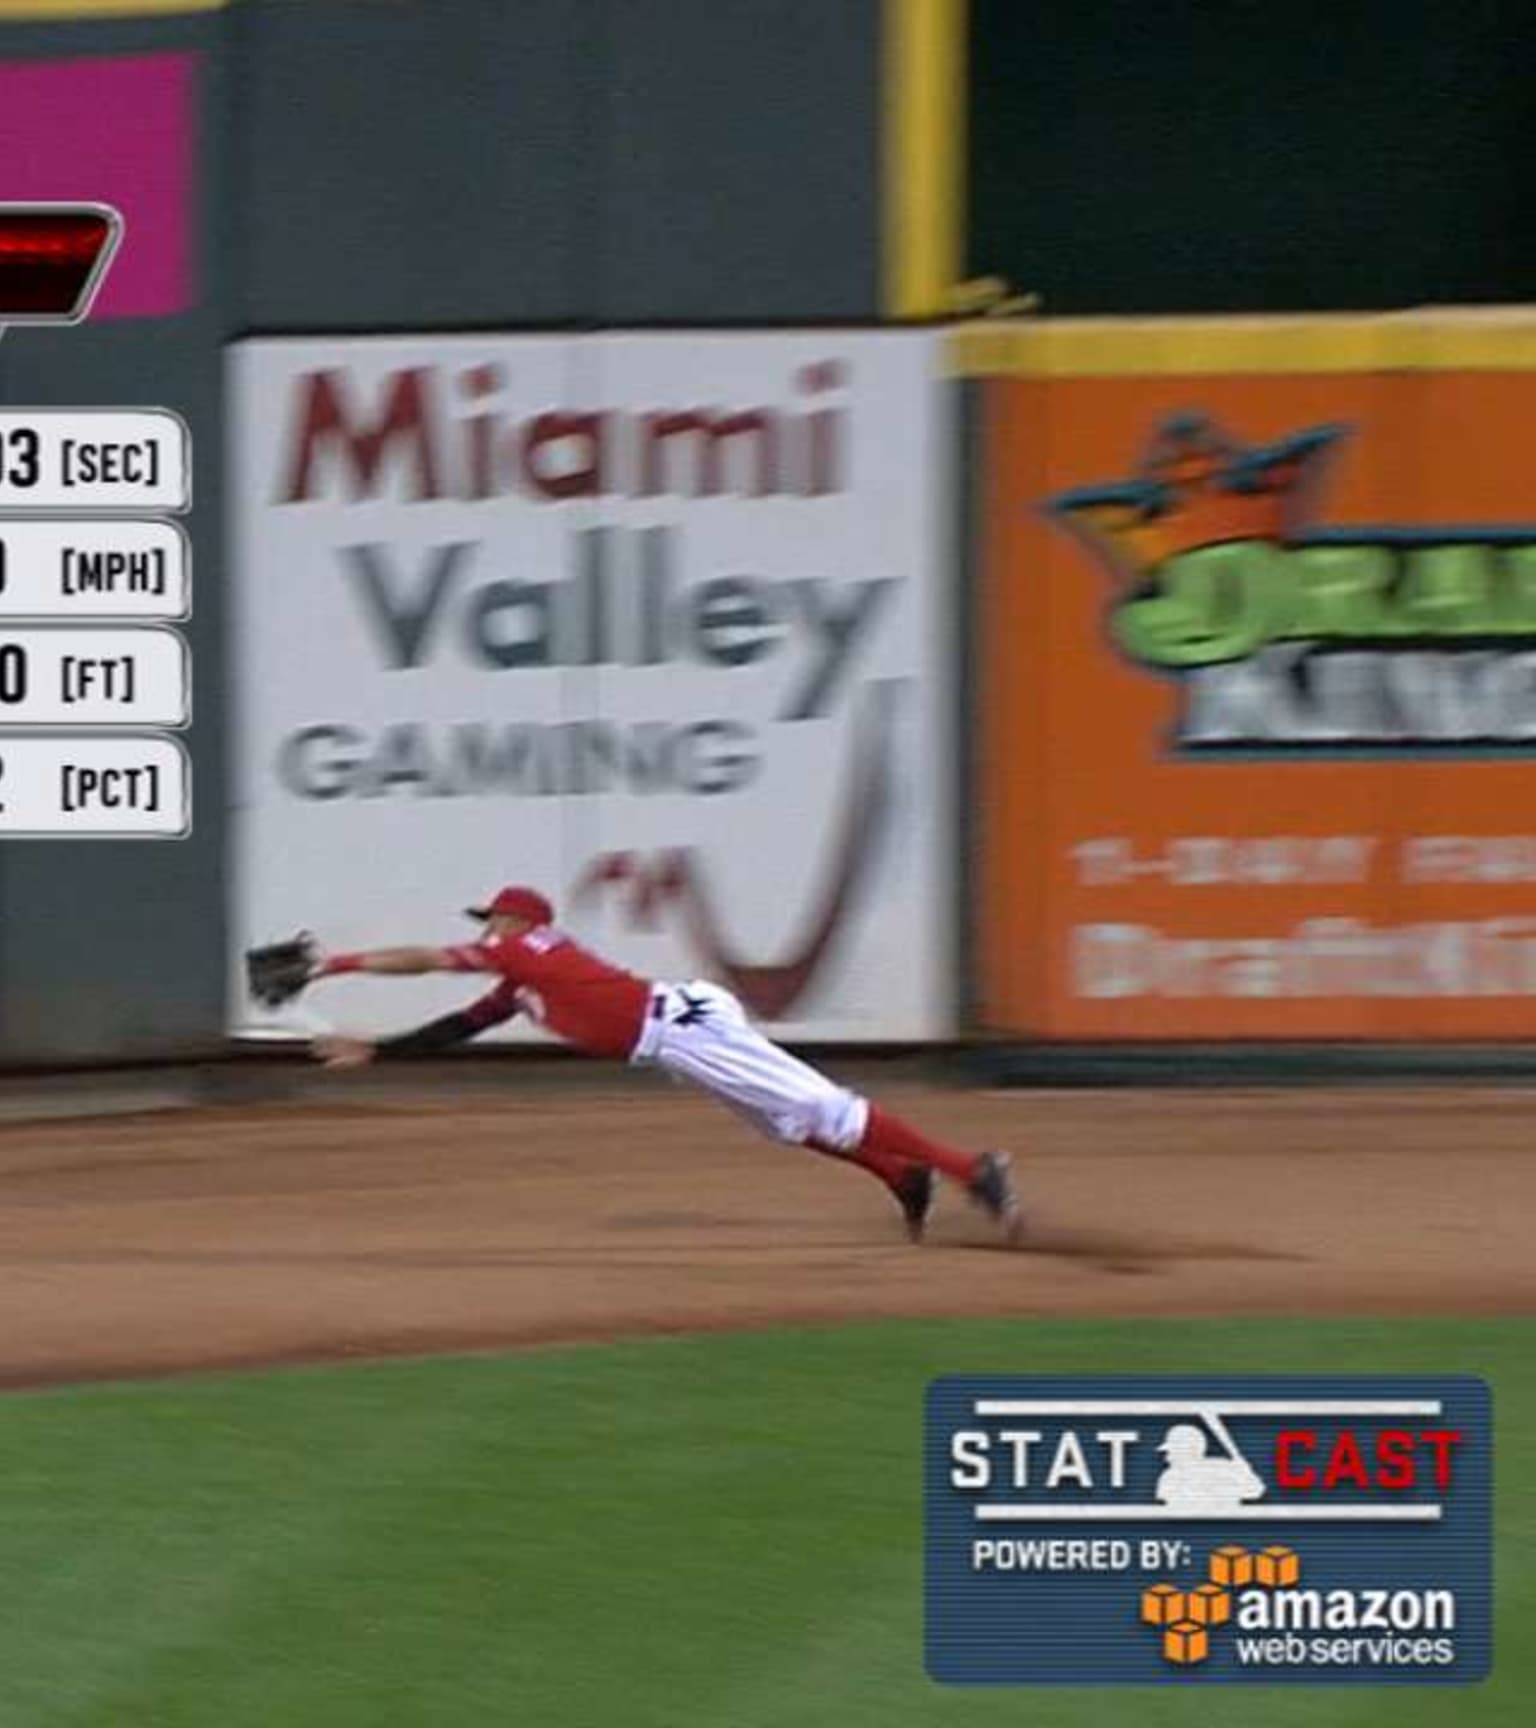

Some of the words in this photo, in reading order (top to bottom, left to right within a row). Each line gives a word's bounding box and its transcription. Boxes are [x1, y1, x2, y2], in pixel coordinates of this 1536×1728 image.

[272, 358, 849, 503] Miami
[339, 524, 905, 722] Valley
[276, 719, 761, 800] GAMING
